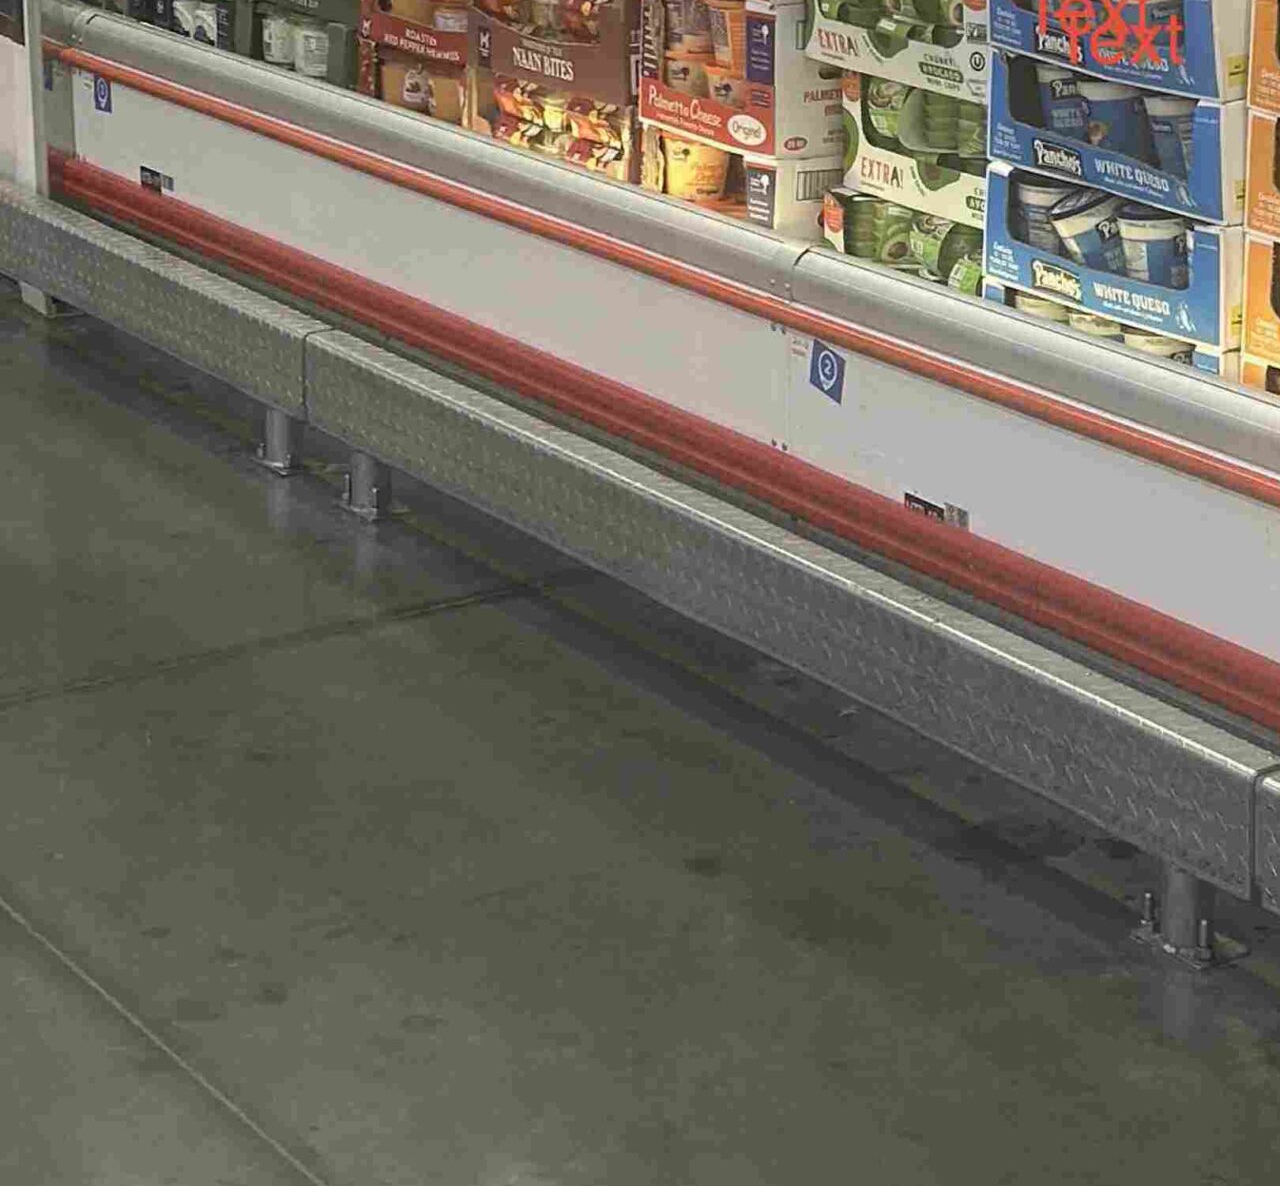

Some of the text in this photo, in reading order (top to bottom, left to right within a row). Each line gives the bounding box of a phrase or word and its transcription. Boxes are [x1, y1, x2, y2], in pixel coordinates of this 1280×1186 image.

[817, 27, 860, 57] EXTRA!
[513, 47, 575, 82] NAAN BITES
[649, 85, 689, 116] Palmetto
[861, 156, 904, 189] EXTRA!
[1095, 158, 1133, 180] WHITE
[1134, 170, 1169, 193] QUESO
[1093, 282, 1131, 304] WHITE
[1132, 292, 1170, 316] QUESO
